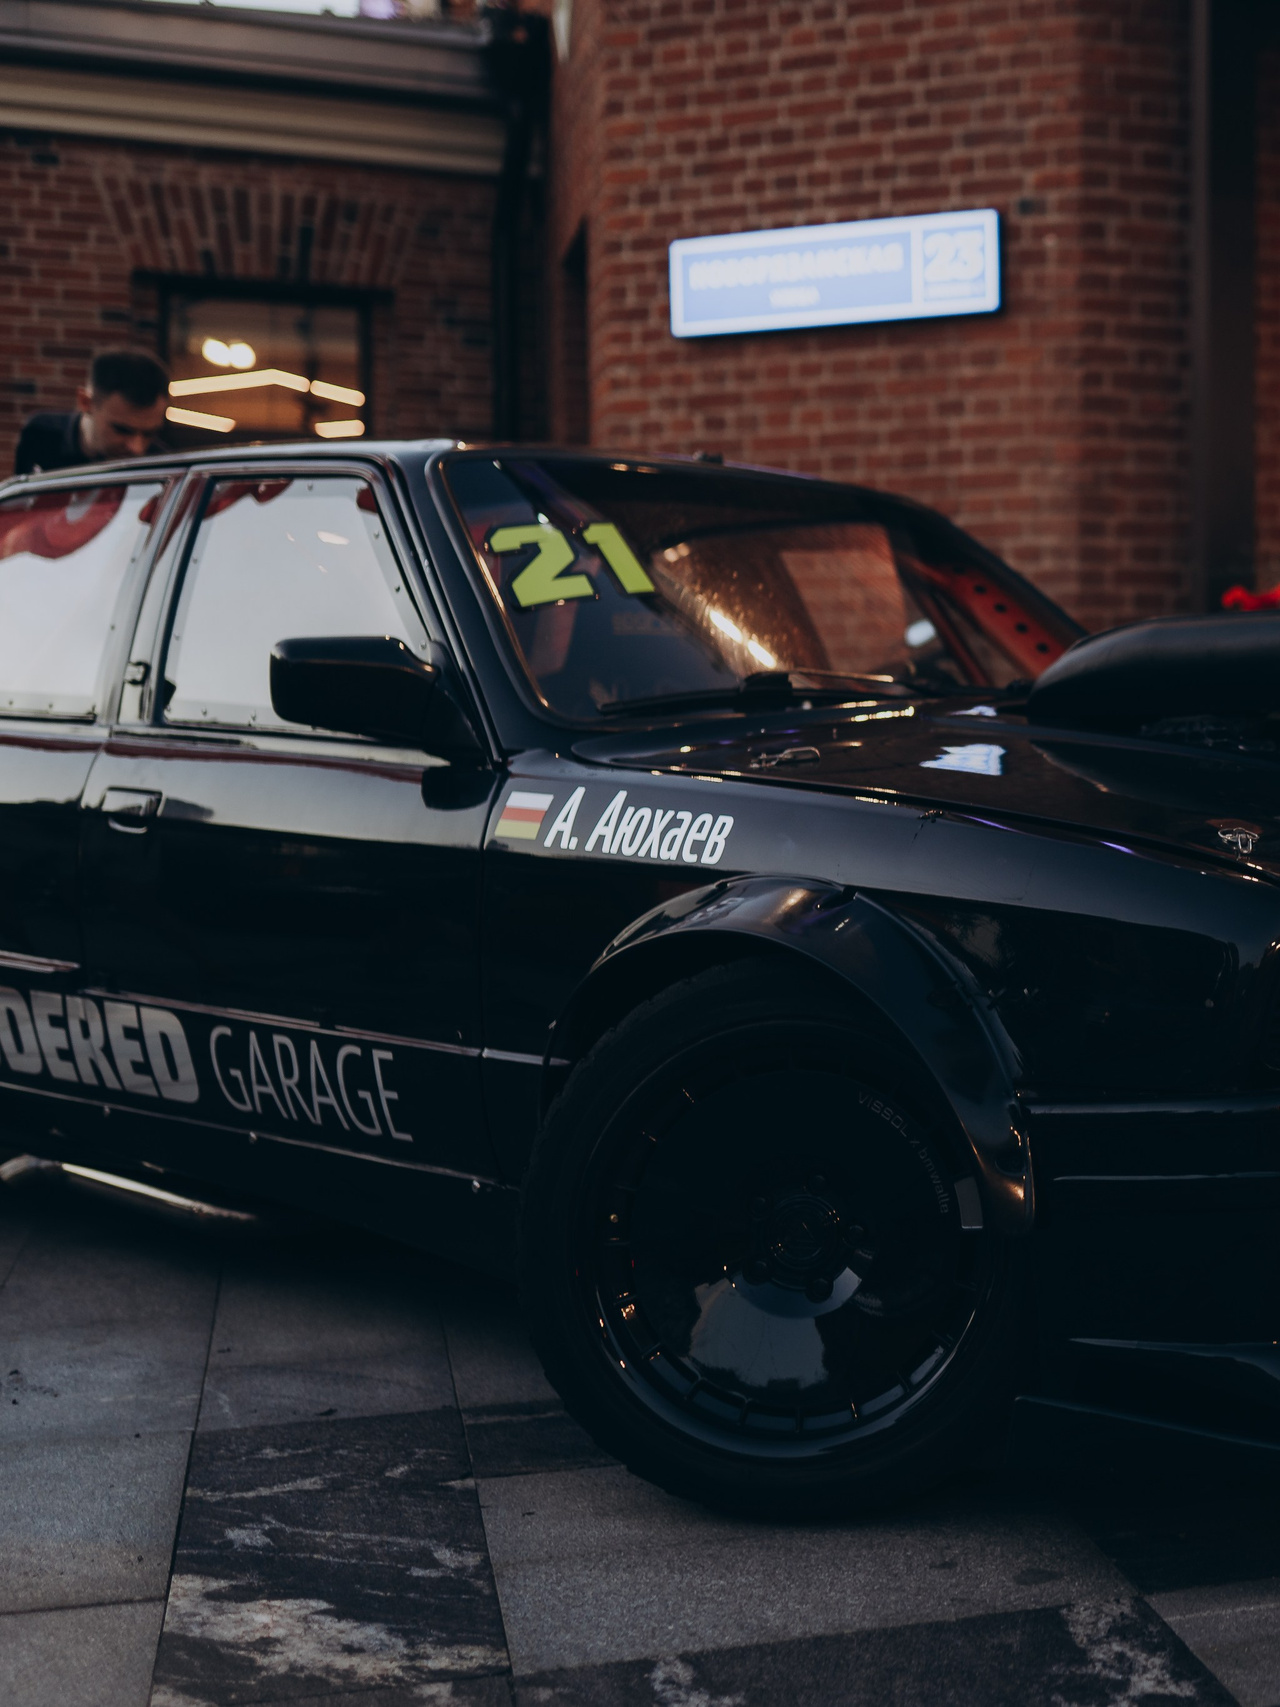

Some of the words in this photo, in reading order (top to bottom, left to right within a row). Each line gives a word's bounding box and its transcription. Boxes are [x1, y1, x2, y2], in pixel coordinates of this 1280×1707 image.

[924, 230, 985, 282] 23
[489, 522, 656, 608] 21
[584, 789, 735, 865] Аюхаев
[209, 1024, 414, 1143] GARAGE
[858, 1090, 908, 1138] VISSOL
